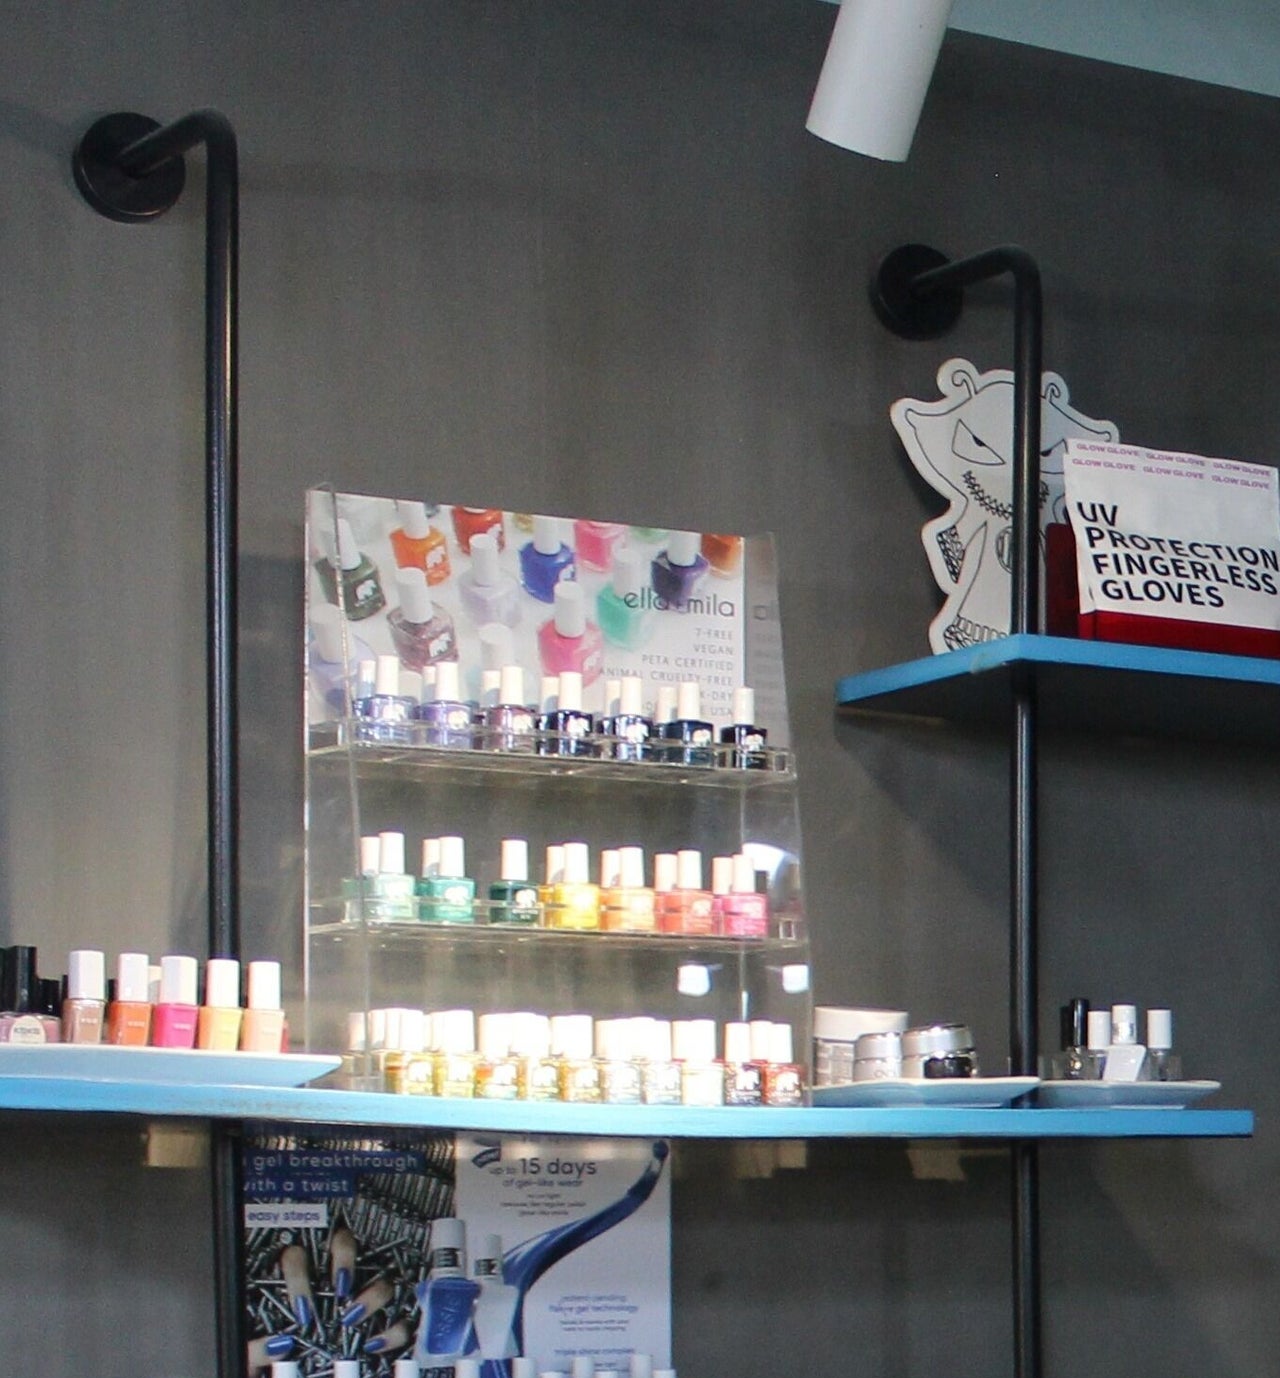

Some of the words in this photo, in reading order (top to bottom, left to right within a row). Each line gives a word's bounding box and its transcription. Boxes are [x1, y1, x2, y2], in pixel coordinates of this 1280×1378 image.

[1076, 502, 1118, 527] UV
[1085, 527, 1279, 572] PROTECTION
[1092, 553, 1278, 595] FINGERLESS
[1101, 579, 1224, 608] GLOVES
[693, 644, 733, 655] VEGAN
[642, 654, 668, 665] PETA
[675, 657, 733, 671] CERTIFIED
[651, 670, 733, 687] CRUELTY-FREE
[253, 1155, 282, 1171] gel
[290, 1155, 417, 1171] breakthrough
[520, 1158, 540, 1175] 15
[547, 1158, 597, 1179] days
[283, 1182, 294, 1192] a
[303, 1179, 349, 1192] twist
[248, 1211, 278, 1223] easy
[283, 1210, 320, 1223] steps
